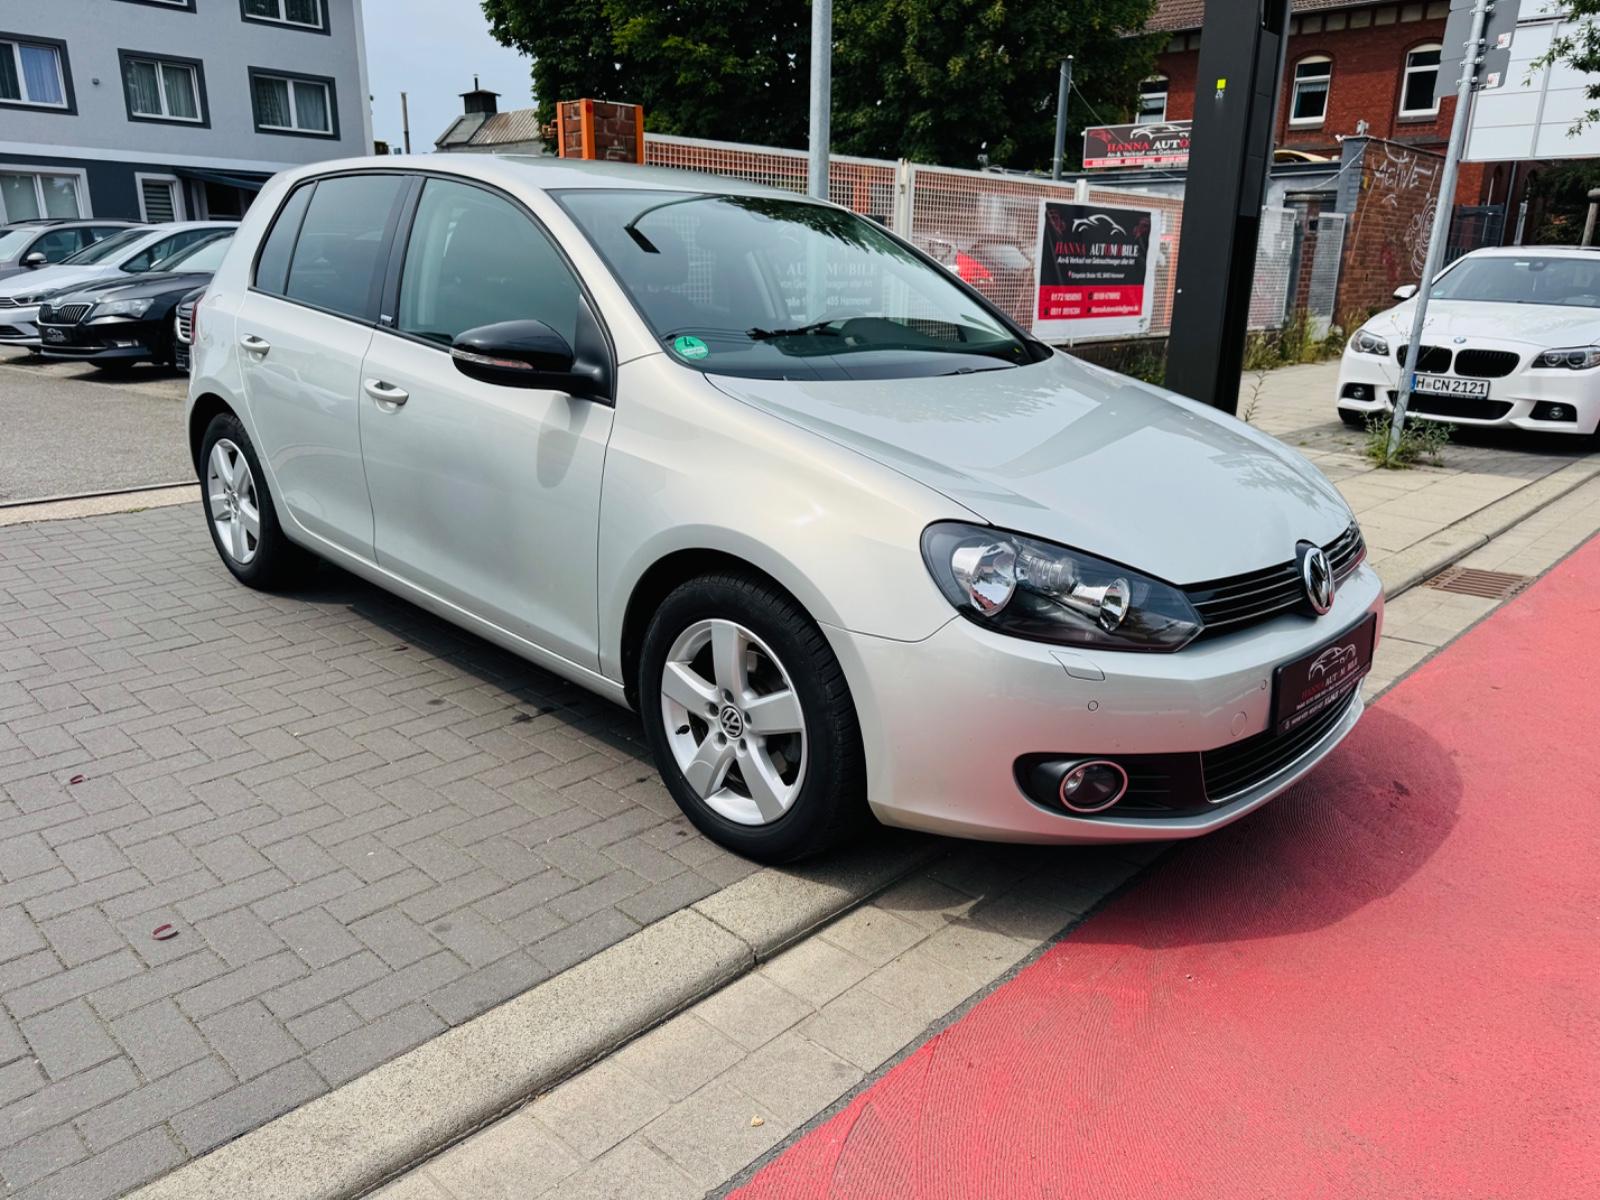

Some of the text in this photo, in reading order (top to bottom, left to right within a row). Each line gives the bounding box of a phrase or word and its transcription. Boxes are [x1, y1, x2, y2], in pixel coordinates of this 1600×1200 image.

[1107, 141, 1150, 152] HANNA
[1055, 241, 1139, 257] HANNA AUTOMOBILE
[683, 336, 695, 348] 4
[1452, 380, 1485, 394] 2121
